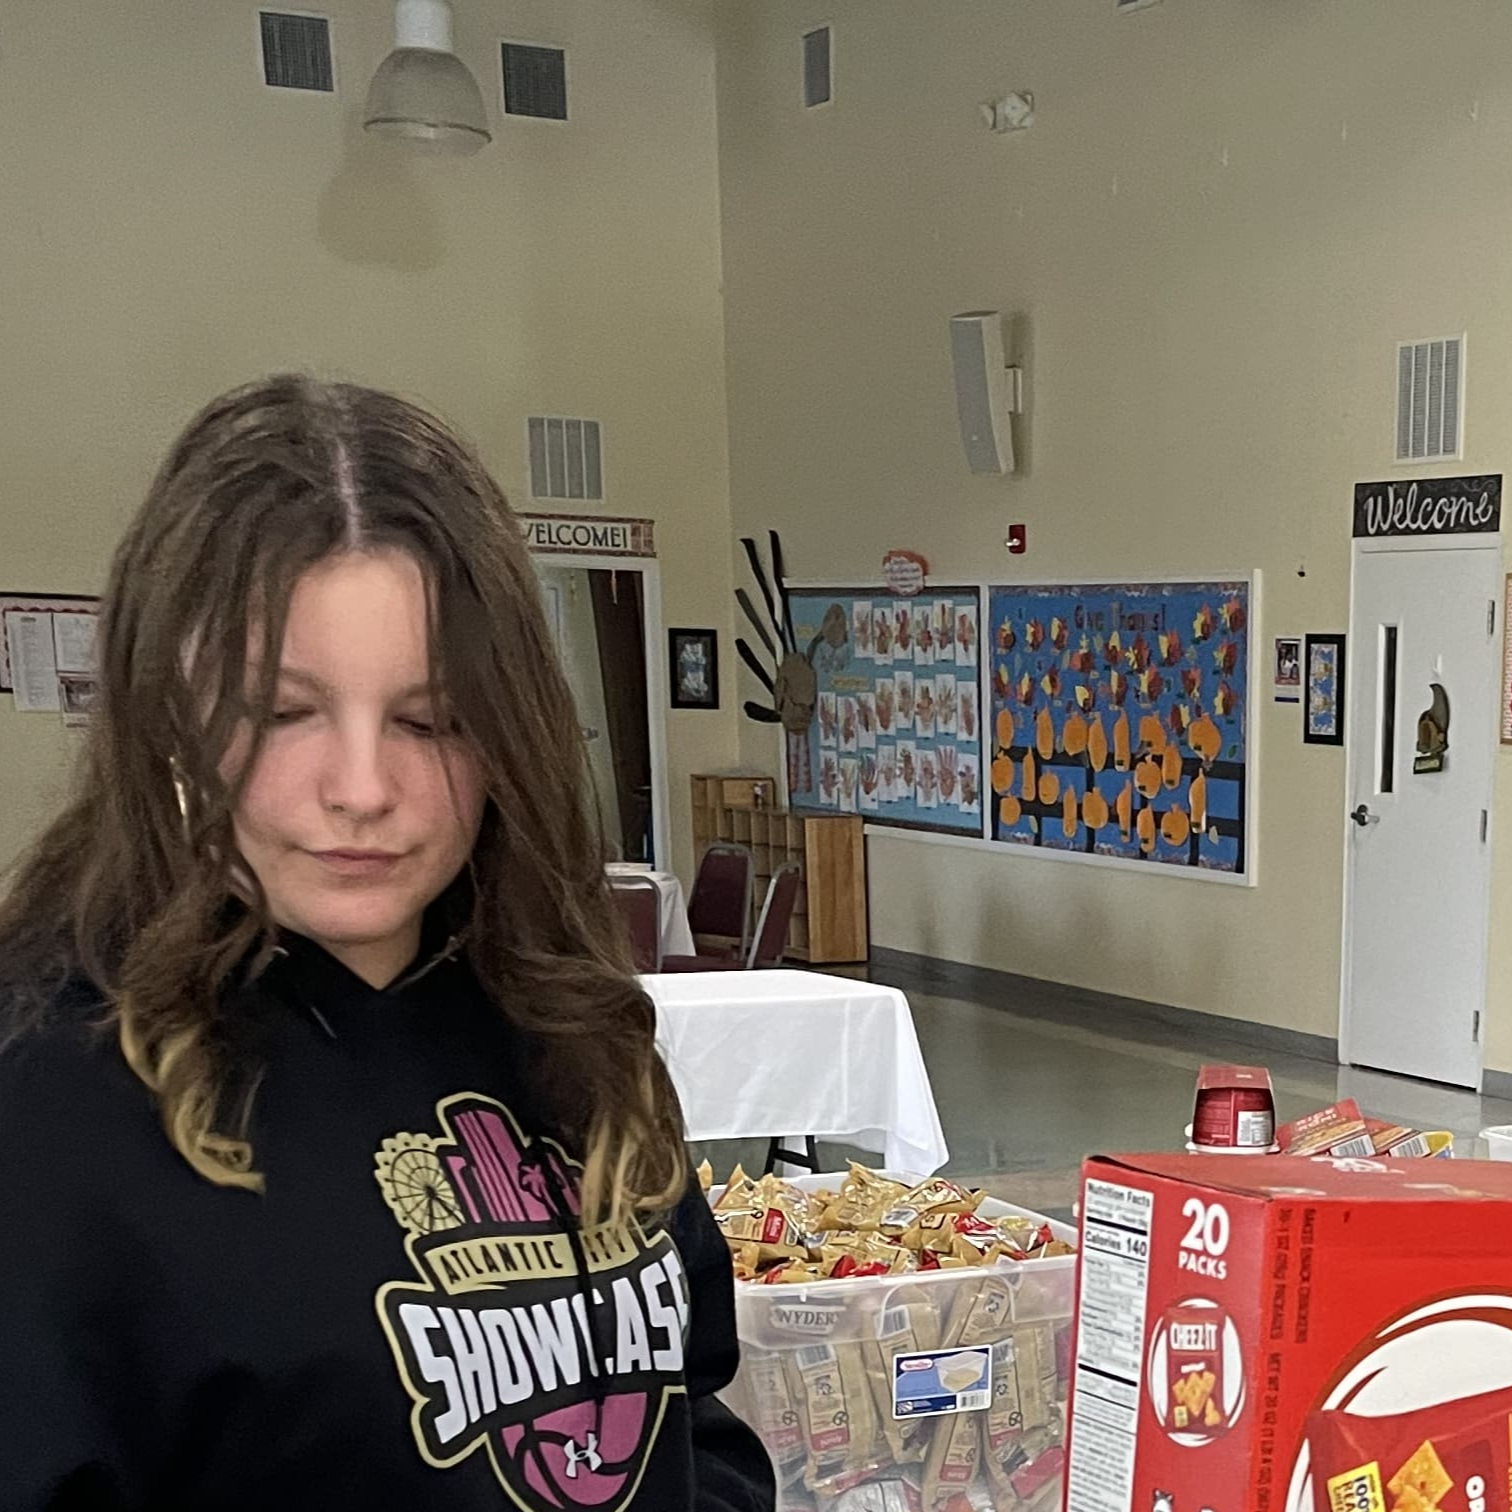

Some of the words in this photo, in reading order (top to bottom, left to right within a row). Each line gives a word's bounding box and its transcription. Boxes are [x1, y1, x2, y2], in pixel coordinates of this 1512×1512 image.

[1364, 483, 1493, 535] Welcome
[526, 522, 628, 549] ELCOME!
[1181, 1198, 1230, 1256] 20
[440, 1240, 564, 1286] ATLANTIC
[1126, 1237, 1147, 1257] 140
[1178, 1250, 1227, 1280] PACKS
